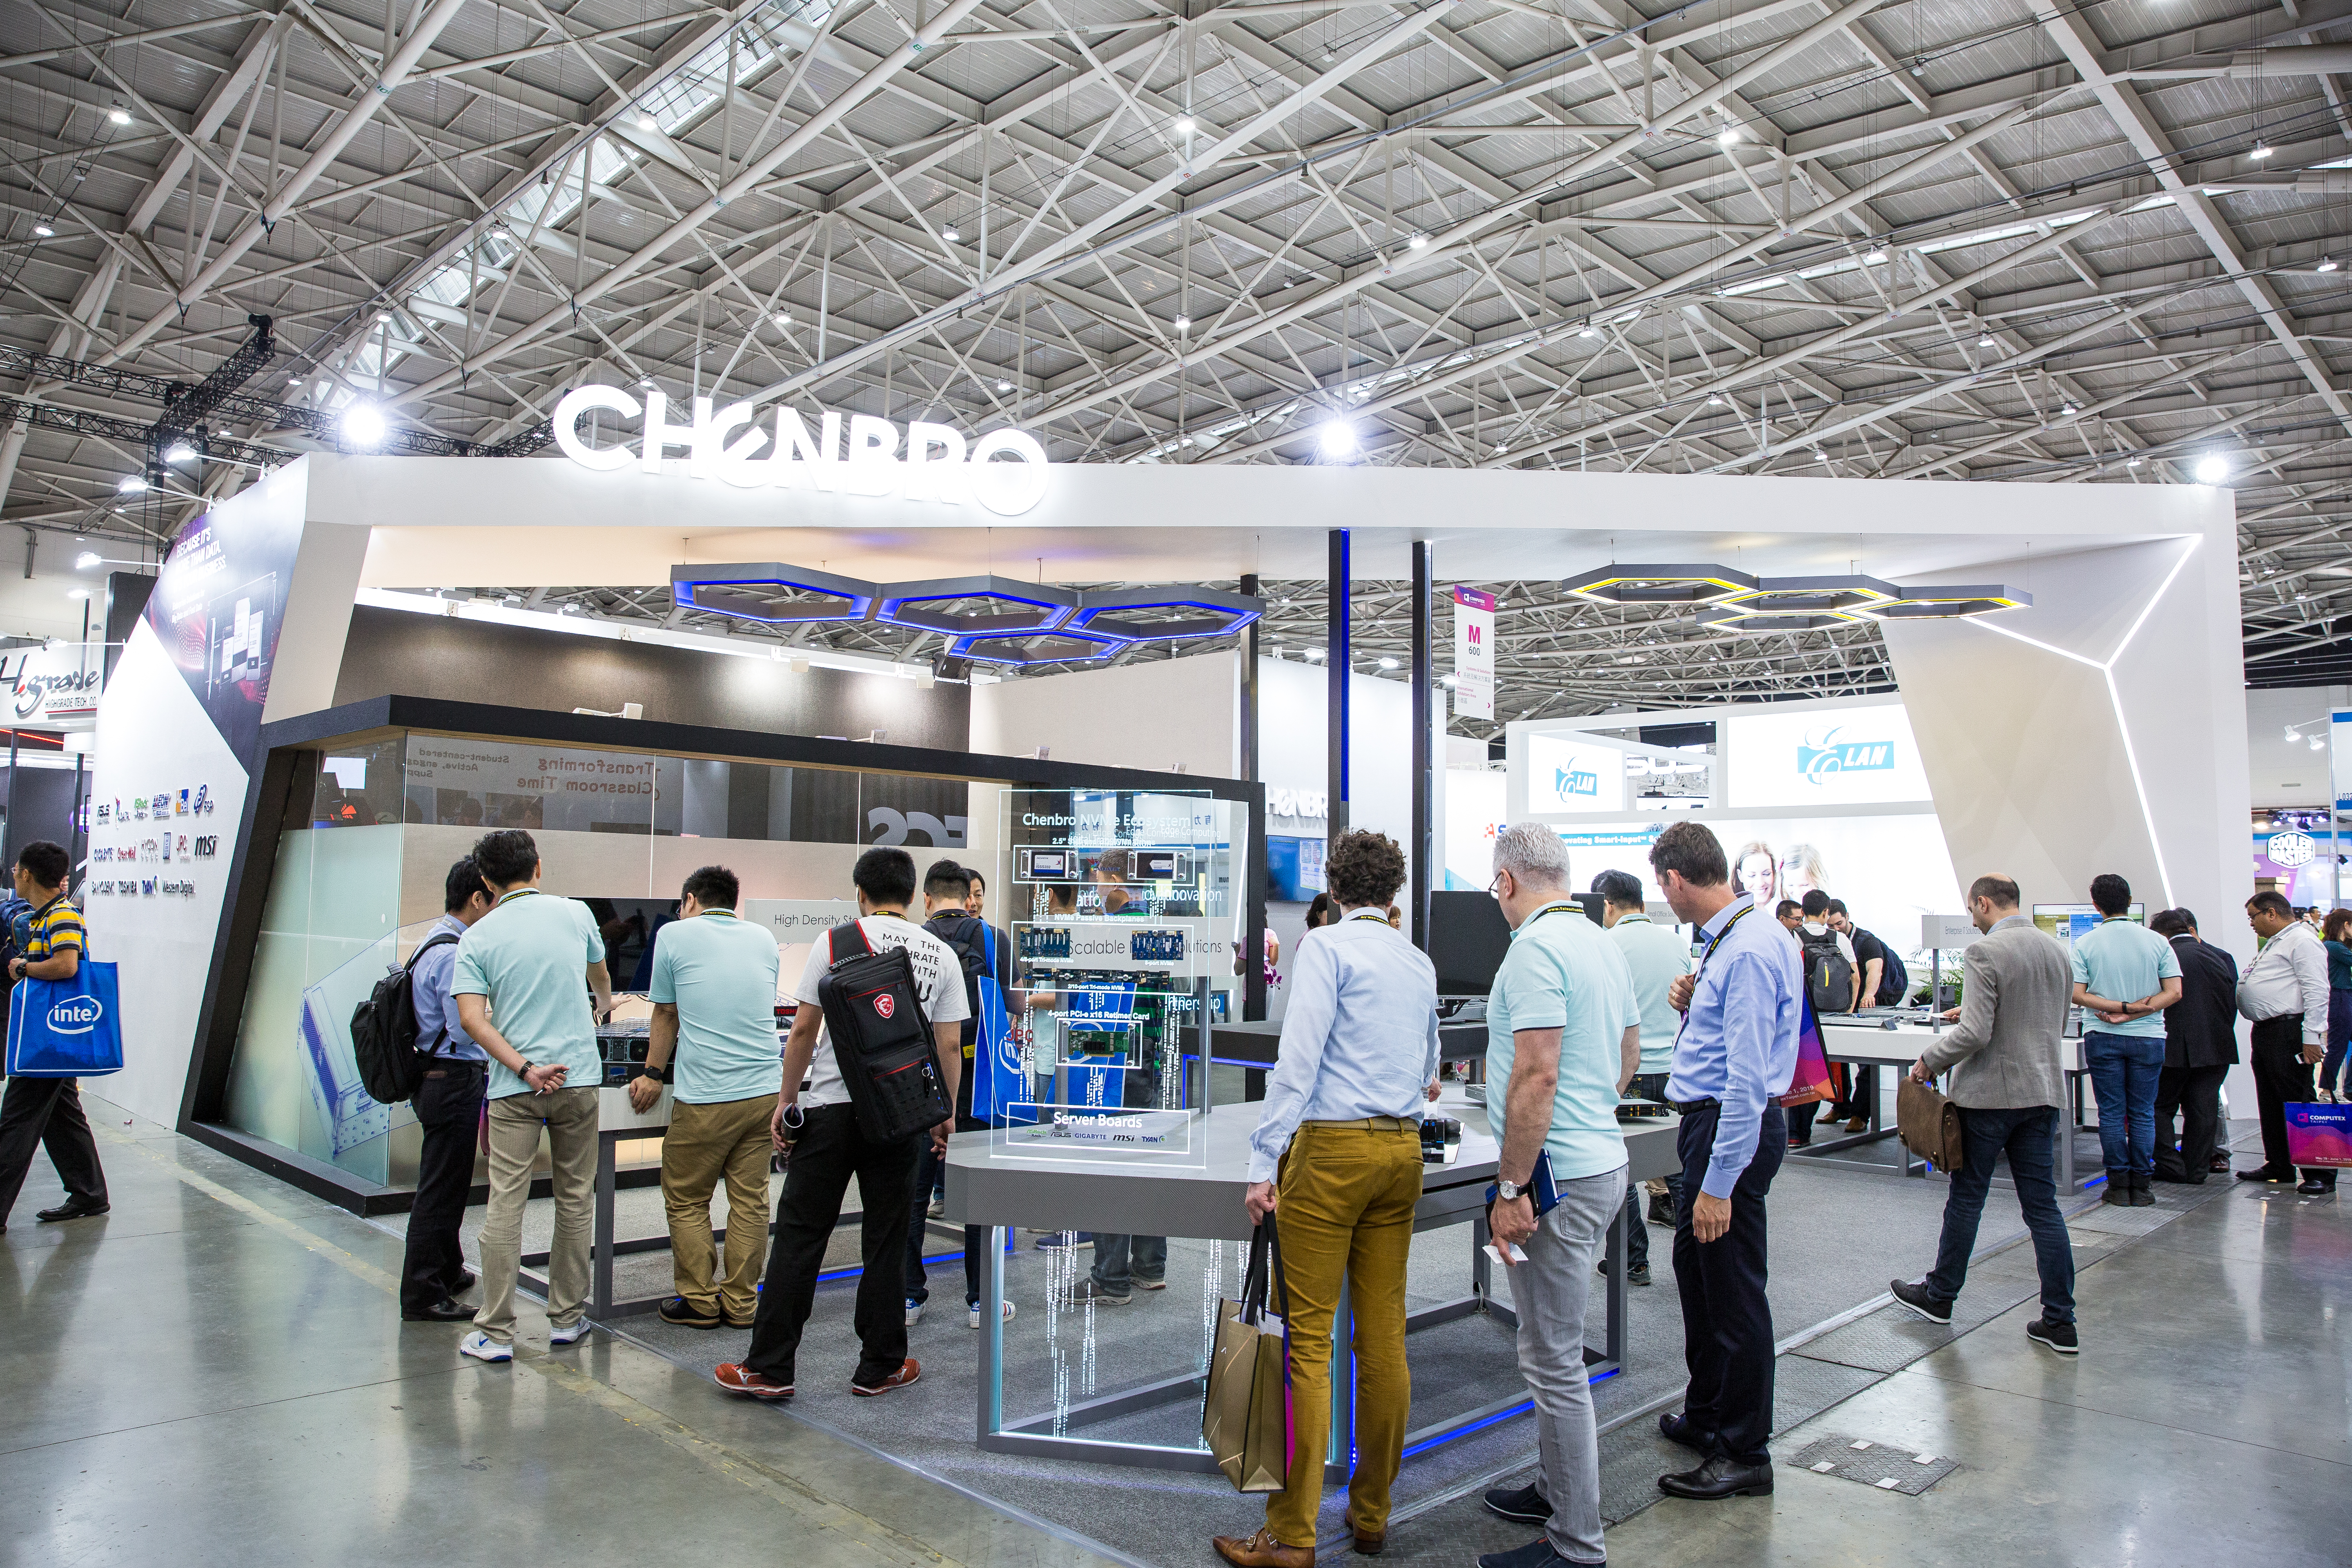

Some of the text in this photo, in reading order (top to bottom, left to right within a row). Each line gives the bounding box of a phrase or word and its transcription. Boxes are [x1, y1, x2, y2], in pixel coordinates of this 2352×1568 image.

[553, 384, 1049, 516] CHENBRO
[177, 526, 211, 559] BECAUSE IT'S
[191, 547, 205, 567] THAN
[205, 539, 222, 560] DATA.
[198, 555, 227, 580] BUSINESS.
[1468, 624, 1480, 644] M
[1468, 646, 1480, 656] 600
[45, 696, 98, 708] HIGHGRADE TECH. CO.
[1265, 787, 1328, 818] HENBR
[1022, 813, 1077, 826] Chenbro
[1080, 813, 1120, 826] NVMe
[1123, 813, 1191, 830] Ecosystem
[195, 835, 217, 856] msi
[2270, 833, 2313, 850] COOLER
[2270, 849, 2313, 866] MASTER
[119, 880, 138, 893] TOSHIBA
[162, 879, 180, 893] Western
[774, 914, 799, 928] High
[802, 914, 840, 927] Density
[1104, 915, 1145, 923] Backplanes
[1945, 926, 1962, 936] Enterprise
[1966, 926, 1981, 934] Solutions
[883, 933, 940, 953] MAY THE
[883, 945, 939, 966] HHRATE
[54, 1004, 92, 1022] inte
[1047, 1009, 1069, 1018] 4-port
[1104, 1011, 1131, 1019] Retimer
[1132, 1012, 1149, 1020] Card
[1007, 1029, 1033, 1042] JPC
[1054, 1111, 1143, 1128] Server Boards
